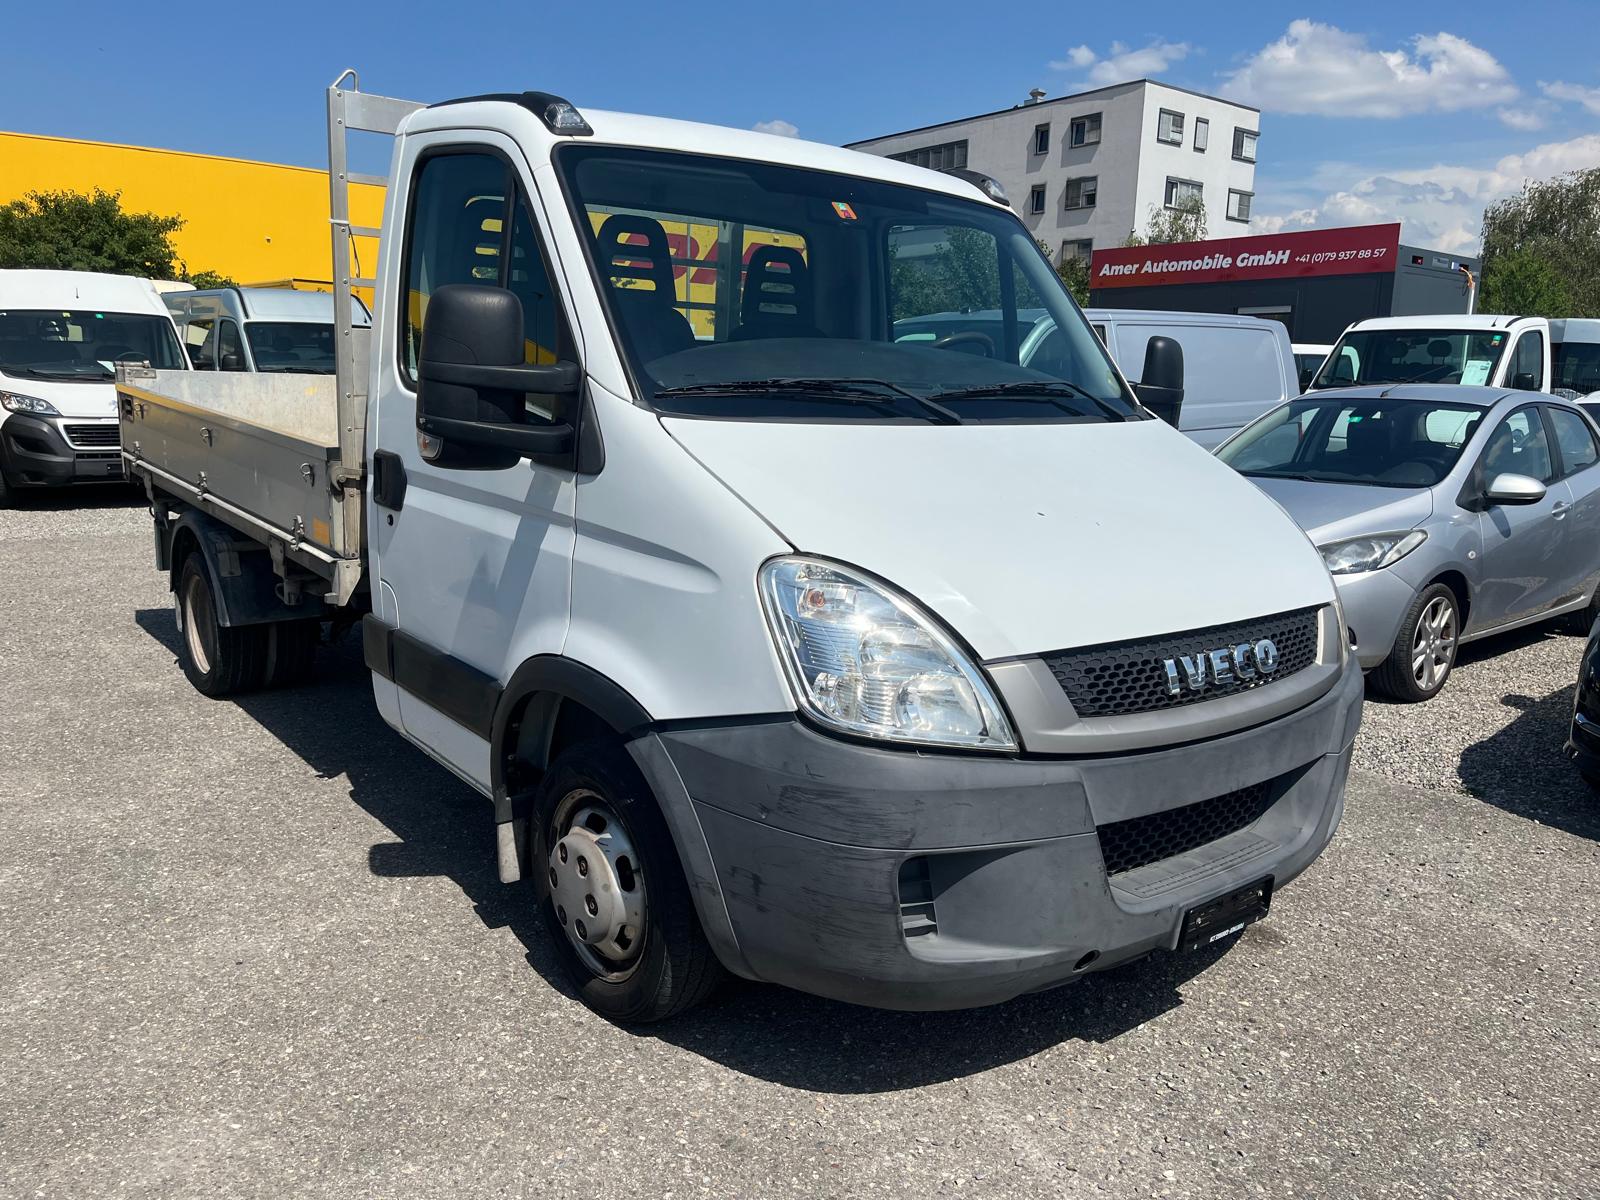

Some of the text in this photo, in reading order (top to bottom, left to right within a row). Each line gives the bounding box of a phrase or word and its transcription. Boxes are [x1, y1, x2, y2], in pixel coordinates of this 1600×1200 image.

[1099, 248, 1387, 277] Amer Automobile GmbH +41 (0)79 937 88 57
[1163, 639, 1278, 695] IVECO
